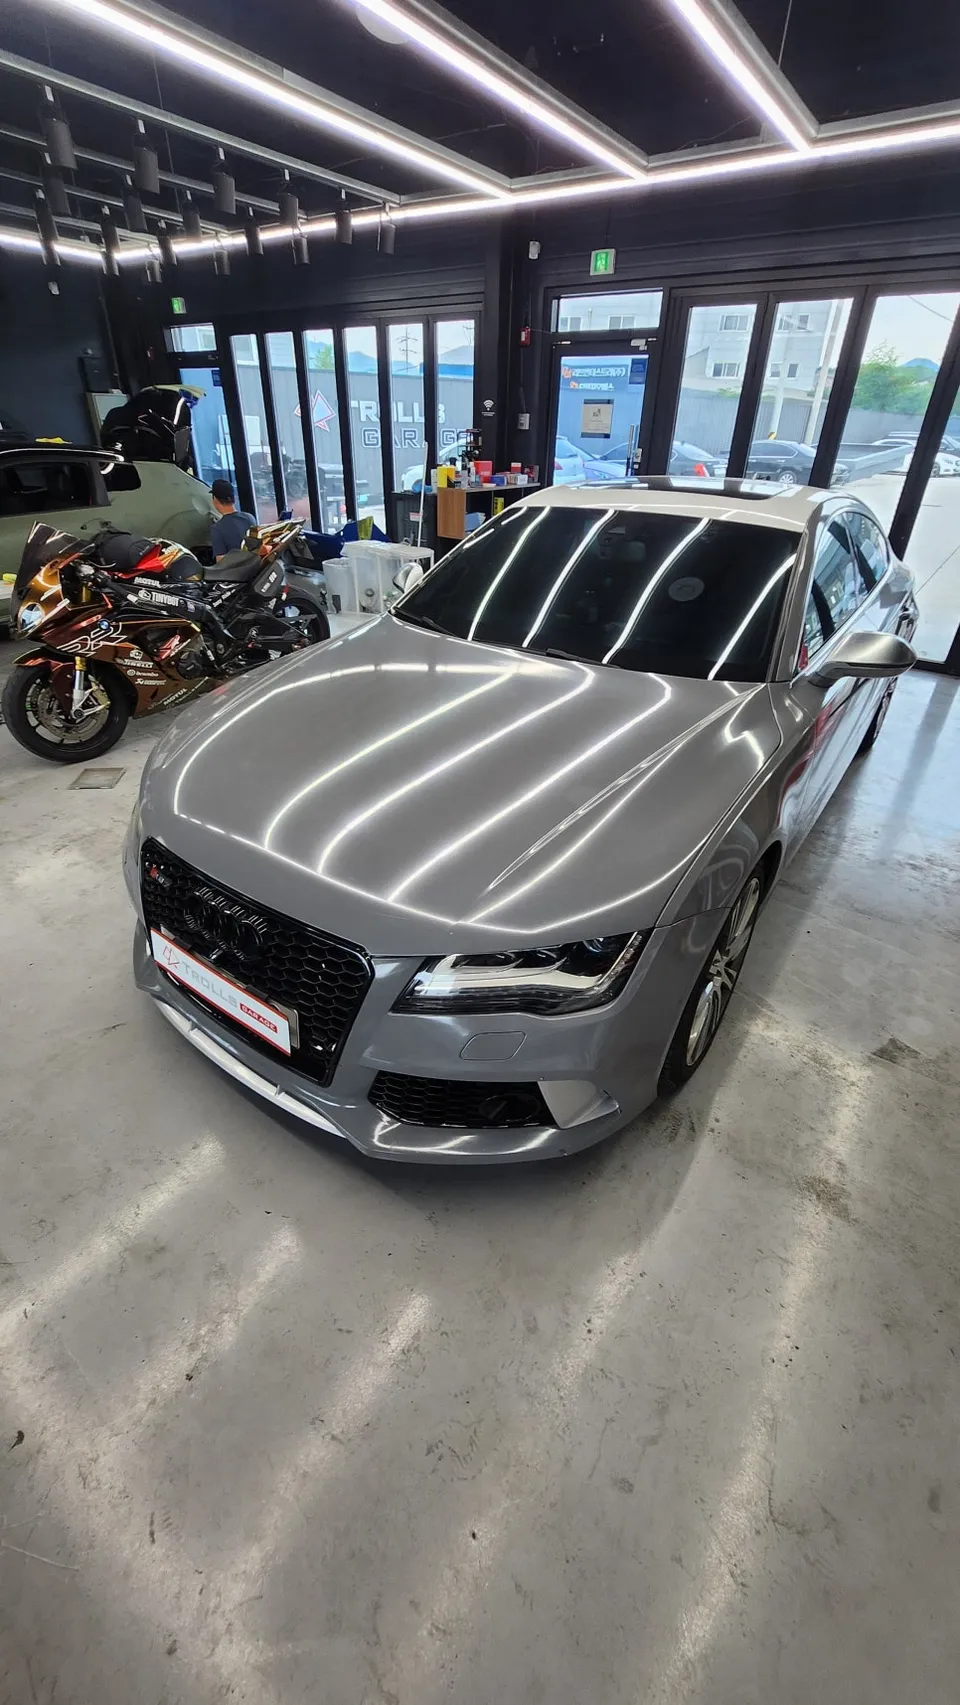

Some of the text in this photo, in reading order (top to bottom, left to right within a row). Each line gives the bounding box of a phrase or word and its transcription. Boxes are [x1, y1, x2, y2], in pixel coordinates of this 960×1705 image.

[134, 576, 161, 588] MOTUL
[151, 591, 179, 607] TINYBOT
[163, 688, 188, 706] MOTUL
[182, 959, 277, 1032] TROLLS GARAGE
